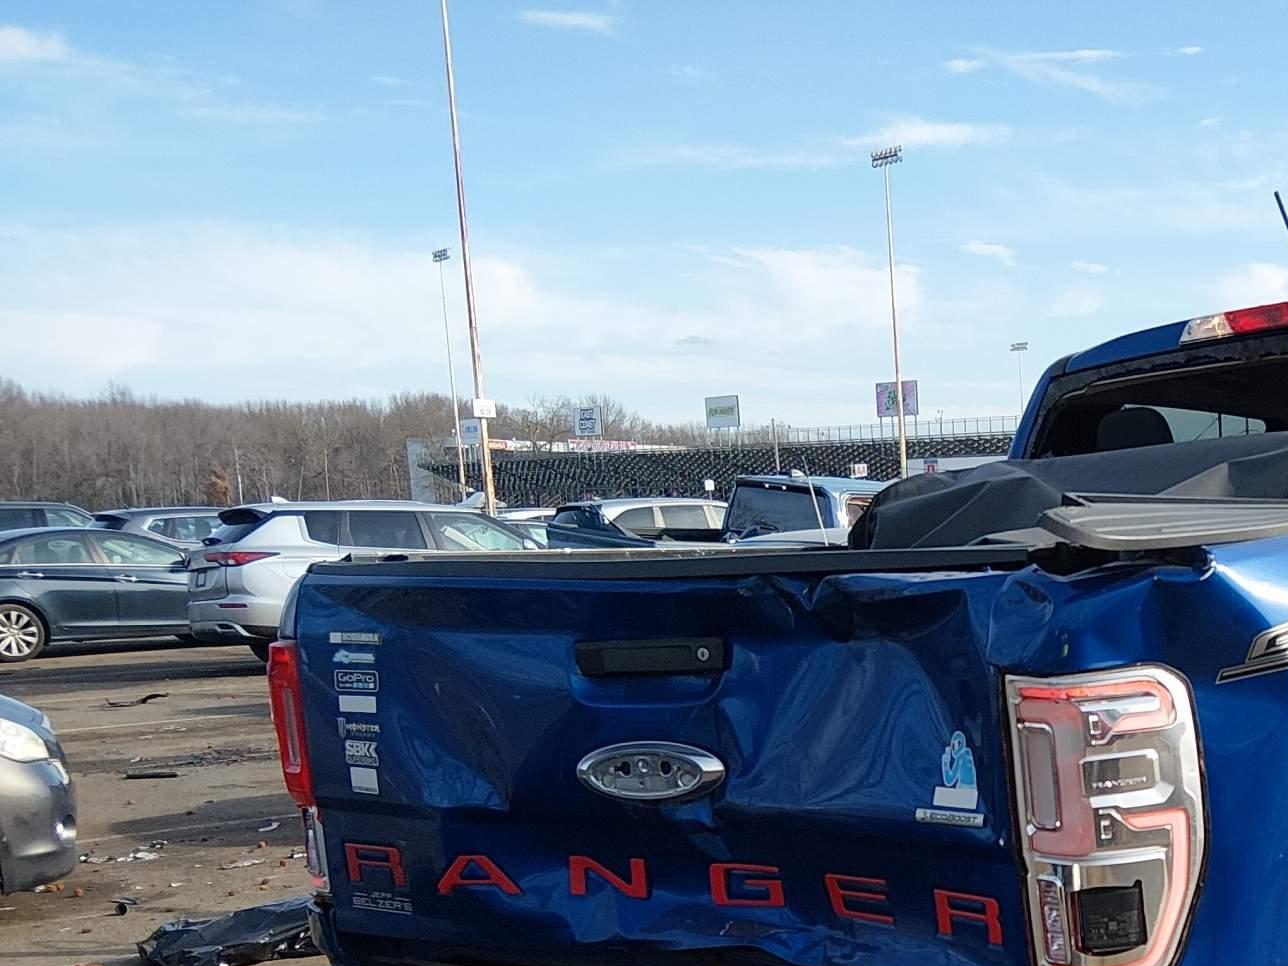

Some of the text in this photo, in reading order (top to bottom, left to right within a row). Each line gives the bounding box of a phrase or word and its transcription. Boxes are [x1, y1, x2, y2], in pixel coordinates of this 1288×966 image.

[338, 673, 374, 683] GoPro
[346, 722, 380, 733] MONSTER
[344, 842, 1003, 946] RANGER
